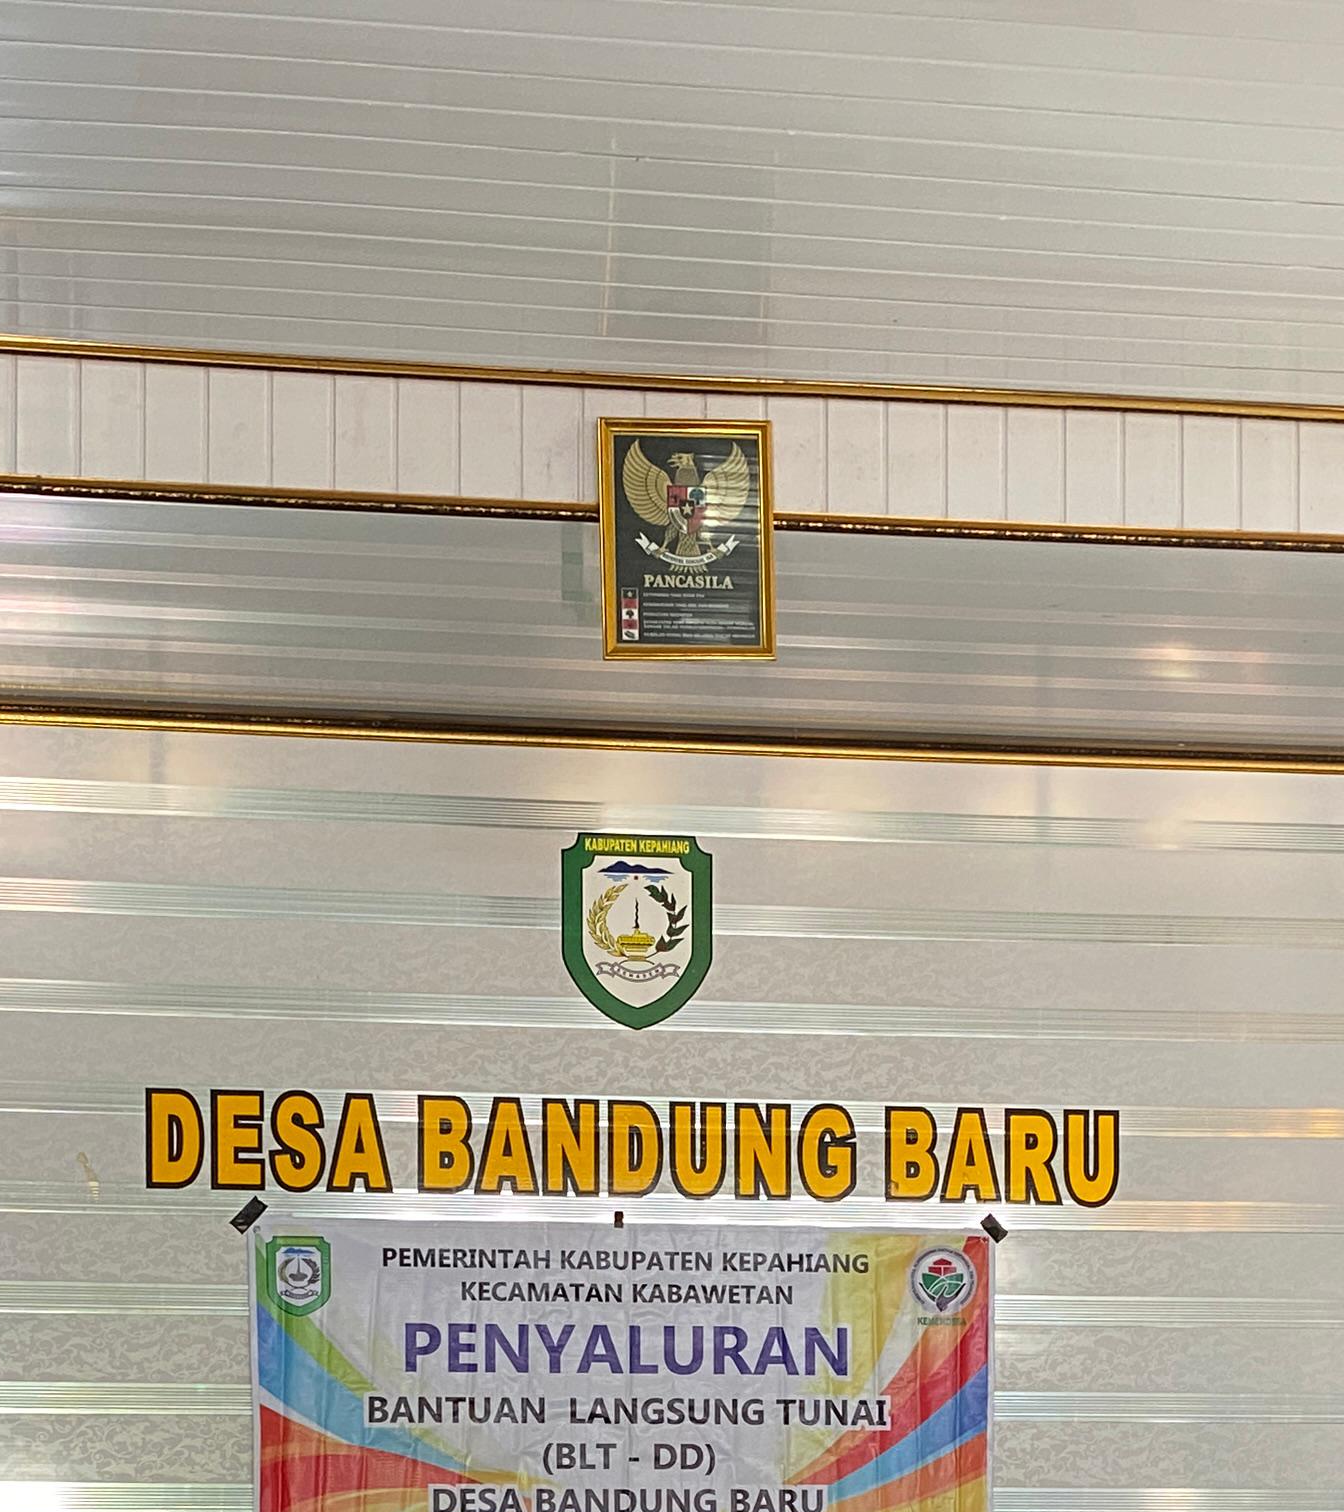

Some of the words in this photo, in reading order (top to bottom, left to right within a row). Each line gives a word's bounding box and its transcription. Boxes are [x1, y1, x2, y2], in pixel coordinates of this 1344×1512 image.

[643, 574, 734, 590] PANCASILA
[584, 837, 637, 852] KABUPATEN
[638, 839, 690, 854] KEPAHIANG
[145, 1087, 394, 1194] DESA
[417, 1095, 856, 1202] BANDUNG
[885, 1106, 1120, 1208] BARU
[382, 1247, 551, 1269] PEMERINTAH
[560, 1250, 713, 1272] KABUPATEN
[722, 1252, 869, 1274] KEPAHIANG
[461, 1281, 623, 1302] KECAMATAN
[632, 1284, 793, 1305] KABAWETAN
[404, 1322, 848, 1376] PENYALURAN
[368, 1396, 546, 1424] BANTUAN
[569, 1397, 765, 1425] LANGSUNG
[776, 1399, 887, 1426] TUNAI
[542, 1442, 617, 1475] (BLT
[653, 1443, 716, 1475] DD)
